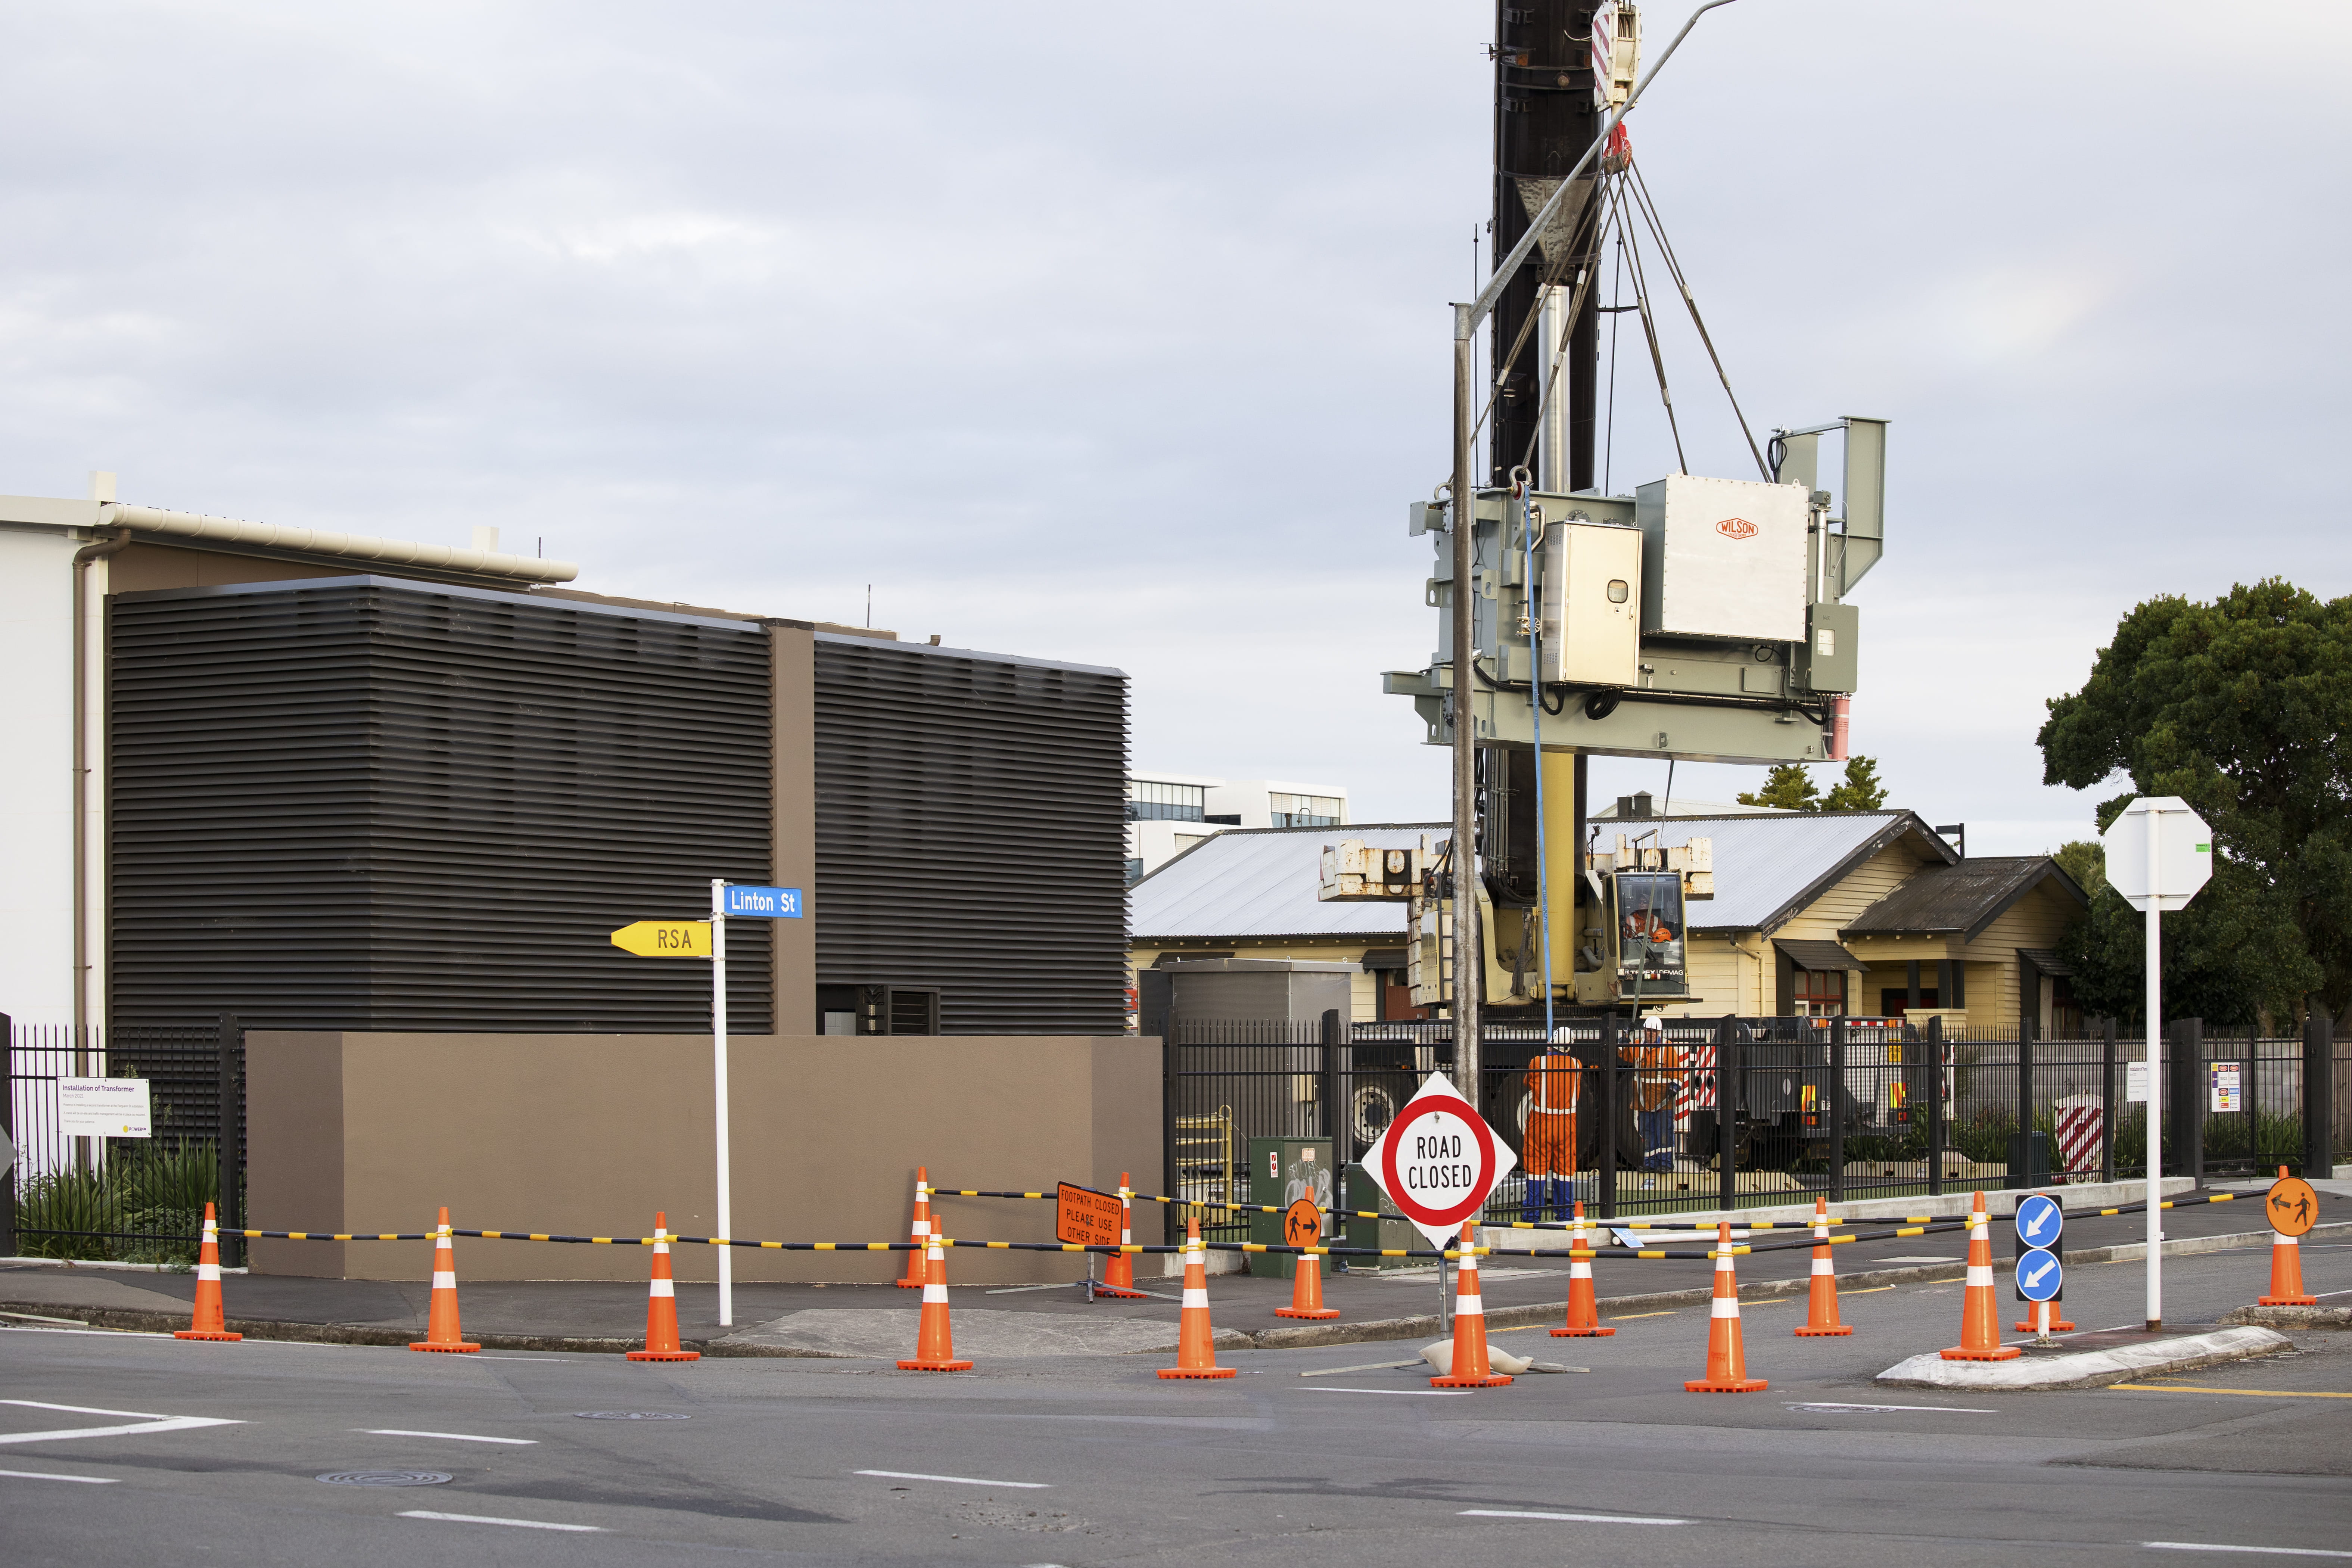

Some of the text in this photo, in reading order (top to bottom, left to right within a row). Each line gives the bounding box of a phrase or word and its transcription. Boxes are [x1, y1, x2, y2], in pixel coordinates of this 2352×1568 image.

[1721, 521, 1754, 534] WILSON
[731, 890, 795, 912] Linton St
[658, 929, 692, 948] RSA
[1417, 1135, 1460, 1159] ROAD
[1409, 1165, 1471, 1189] CLOSED
[1061, 1189, 1119, 1215] FOOTPATH CLOSED
[1099, 1217, 1112, 1231] USE
[1068, 1227, 1110, 1245] OTHER SIDE
